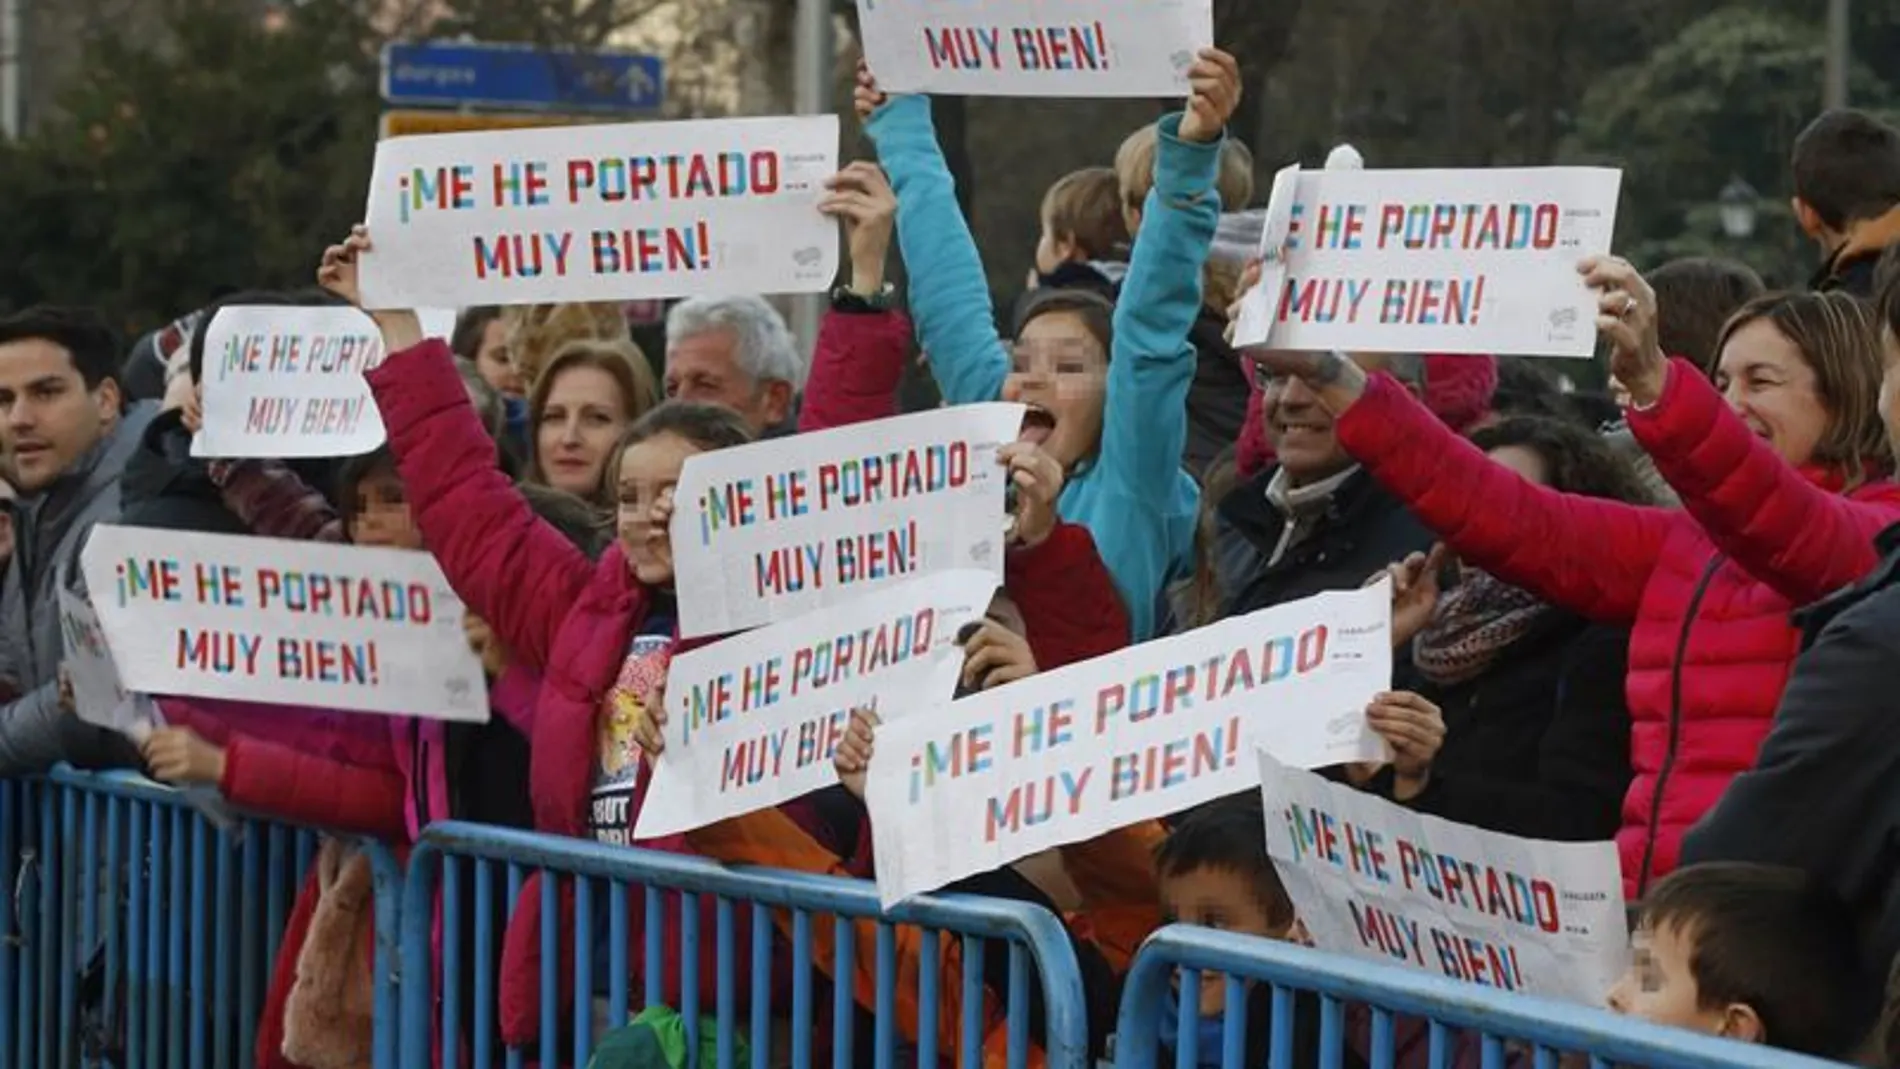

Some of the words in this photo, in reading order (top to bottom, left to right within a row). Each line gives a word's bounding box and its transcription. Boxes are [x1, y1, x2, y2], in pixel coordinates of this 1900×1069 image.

[925, 27, 1000, 70] MUY
[1012, 21, 1109, 71] BIEN!
[400, 167, 474, 223] ¡ME
[493, 162, 549, 206] HE
[568, 150, 778, 203] PORTADO
[473, 232, 571, 279] MUY
[592, 222, 711, 274] BIEN!
[1315, 204, 1366, 249] HE
[1377, 203, 1560, 250] PORTADO
[1278, 278, 1371, 322] MUY
[1380, 275, 1486, 325] BIEN!
[219, 334, 264, 381] ¡ME
[268, 335, 303, 372] HE
[305, 335, 380, 373] PORTA
[246, 397, 298, 434] MUY
[301, 394, 366, 434] BIEN!
[699, 480, 756, 545] ¡ME
[765, 470, 808, 520] HE
[819, 440, 968, 511] PORTADO
[116, 557, 182, 608] ¡ME
[195, 563, 245, 605] HE
[256, 568, 432, 624] PORTADO
[755, 542, 824, 598] MUY
[836, 521, 917, 584] BIEN!
[177, 628, 262, 675] MUY
[278, 637, 379, 685] BIEN!
[682, 674, 733, 746] ¡ME
[741, 657, 783, 711] HE
[791, 608, 935, 695] PORTADO
[720, 728, 788, 792] MUY
[796, 694, 878, 768] BIE
[909, 723, 994, 805] ¡ME
[1012, 699, 1074, 758] HE
[1095, 625, 1329, 735] PORTADO
[984, 766, 1093, 842] MUY
[1110, 717, 1240, 800] BIEN!
[1284, 802, 1342, 863] ¡ME
[1344, 821, 1391, 884] HE
[1396, 838, 1560, 934] PORTADO
[1348, 899, 1425, 967] MUY
[1429, 926, 1524, 992] BIEN!
